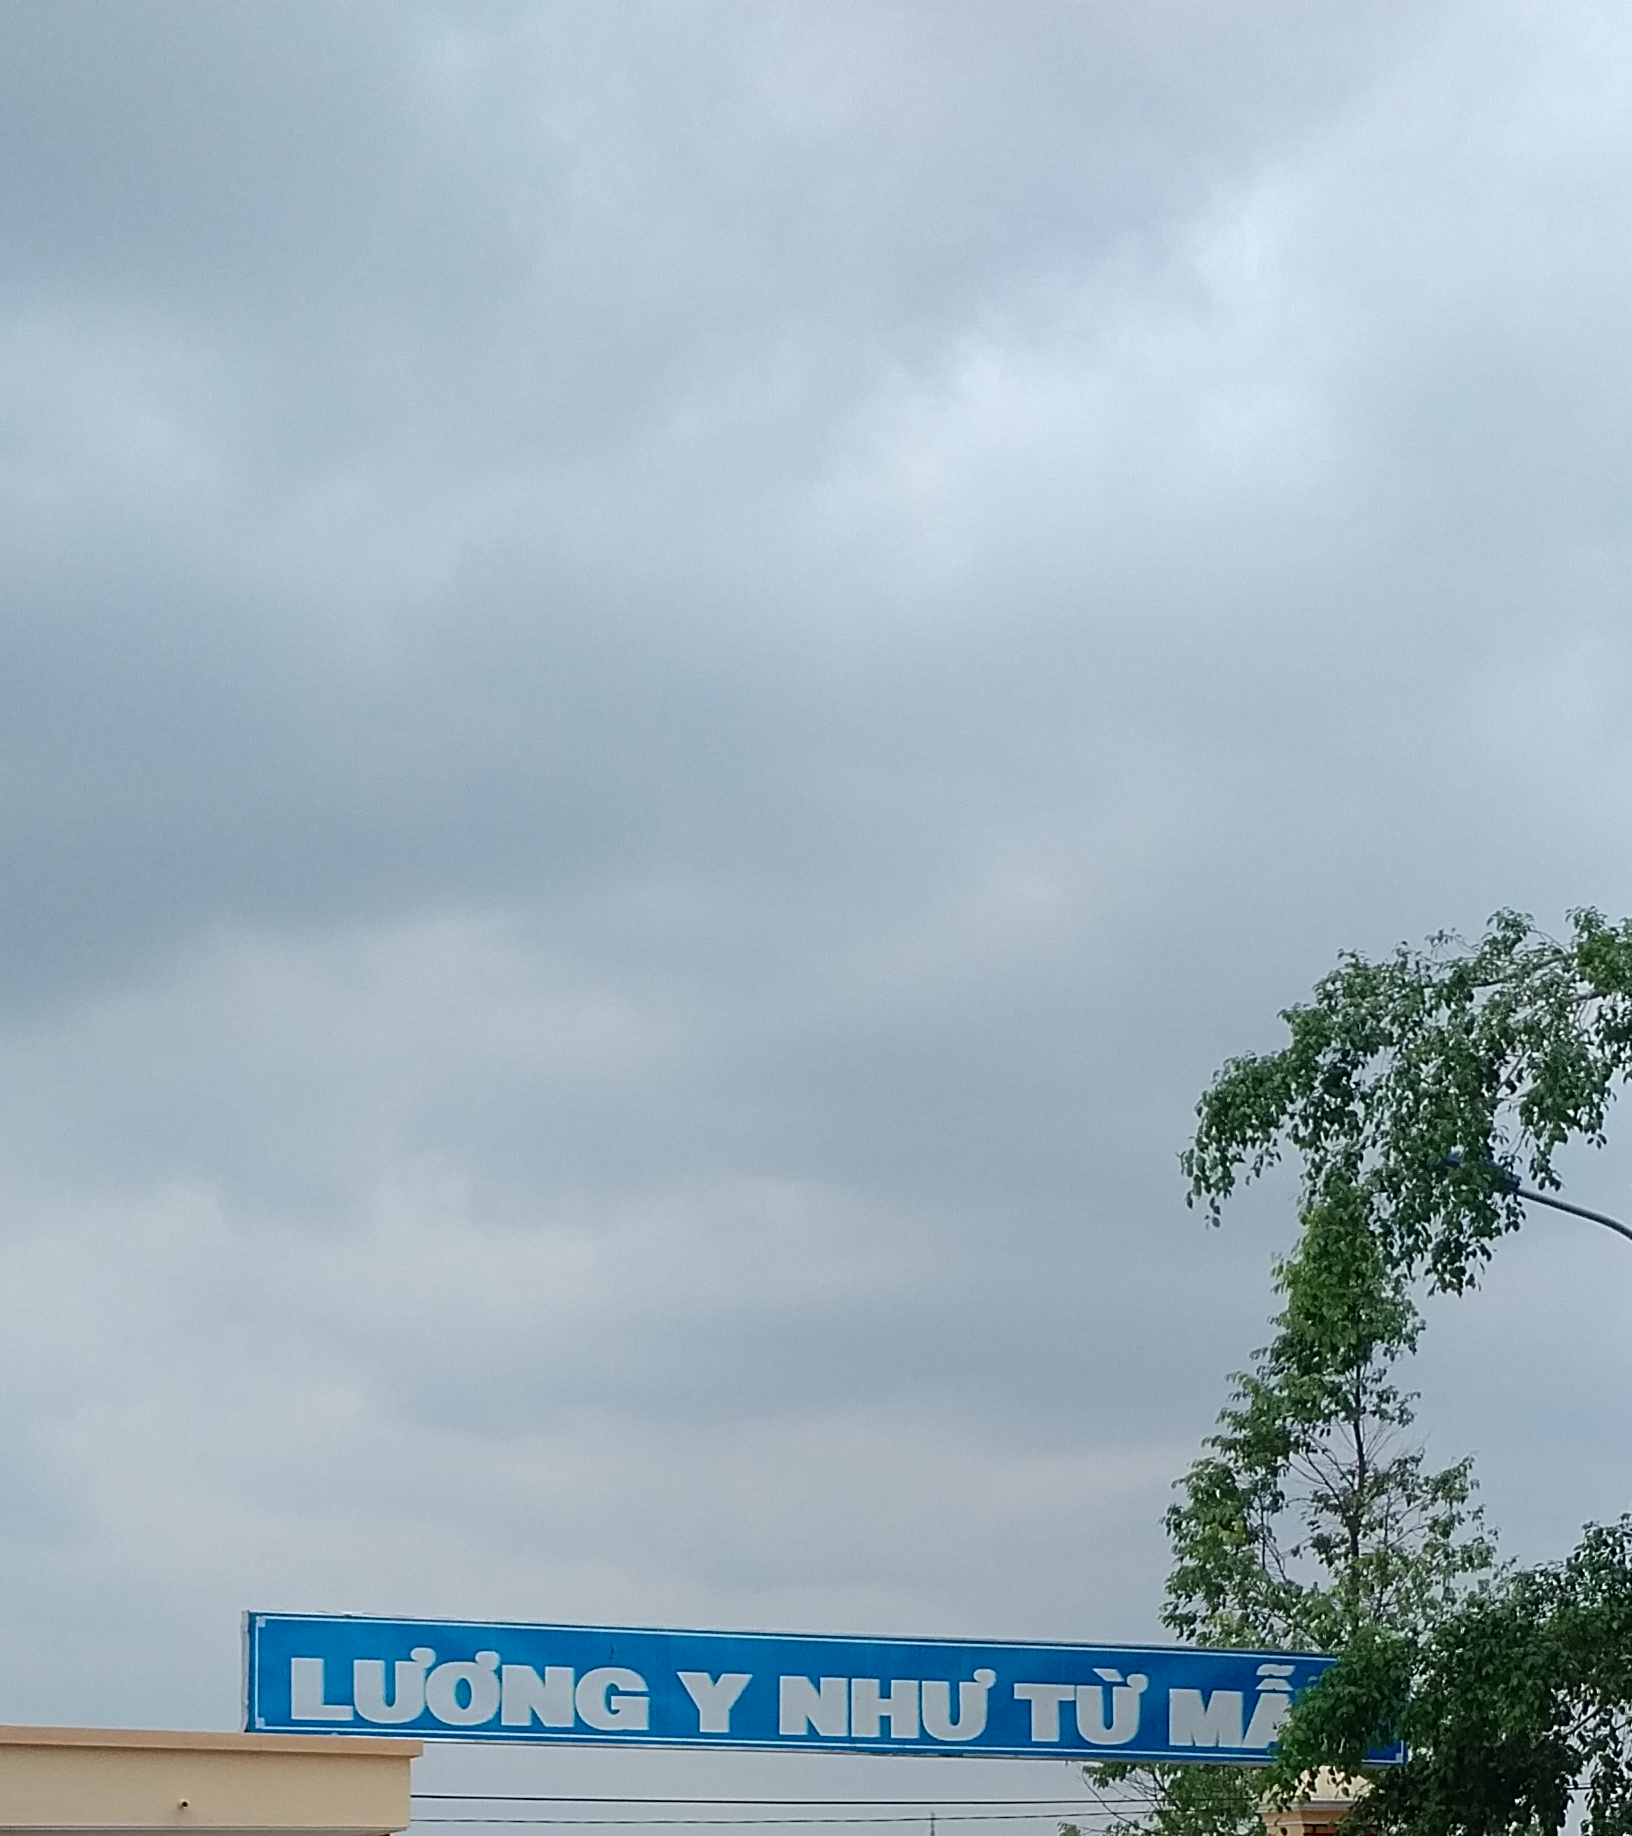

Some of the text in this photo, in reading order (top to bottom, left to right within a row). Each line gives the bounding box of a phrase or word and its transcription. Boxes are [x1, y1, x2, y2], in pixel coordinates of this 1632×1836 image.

[290, 1647, 1296, 1749] LƯƠNG Y NHƯ TỪ MẪ
